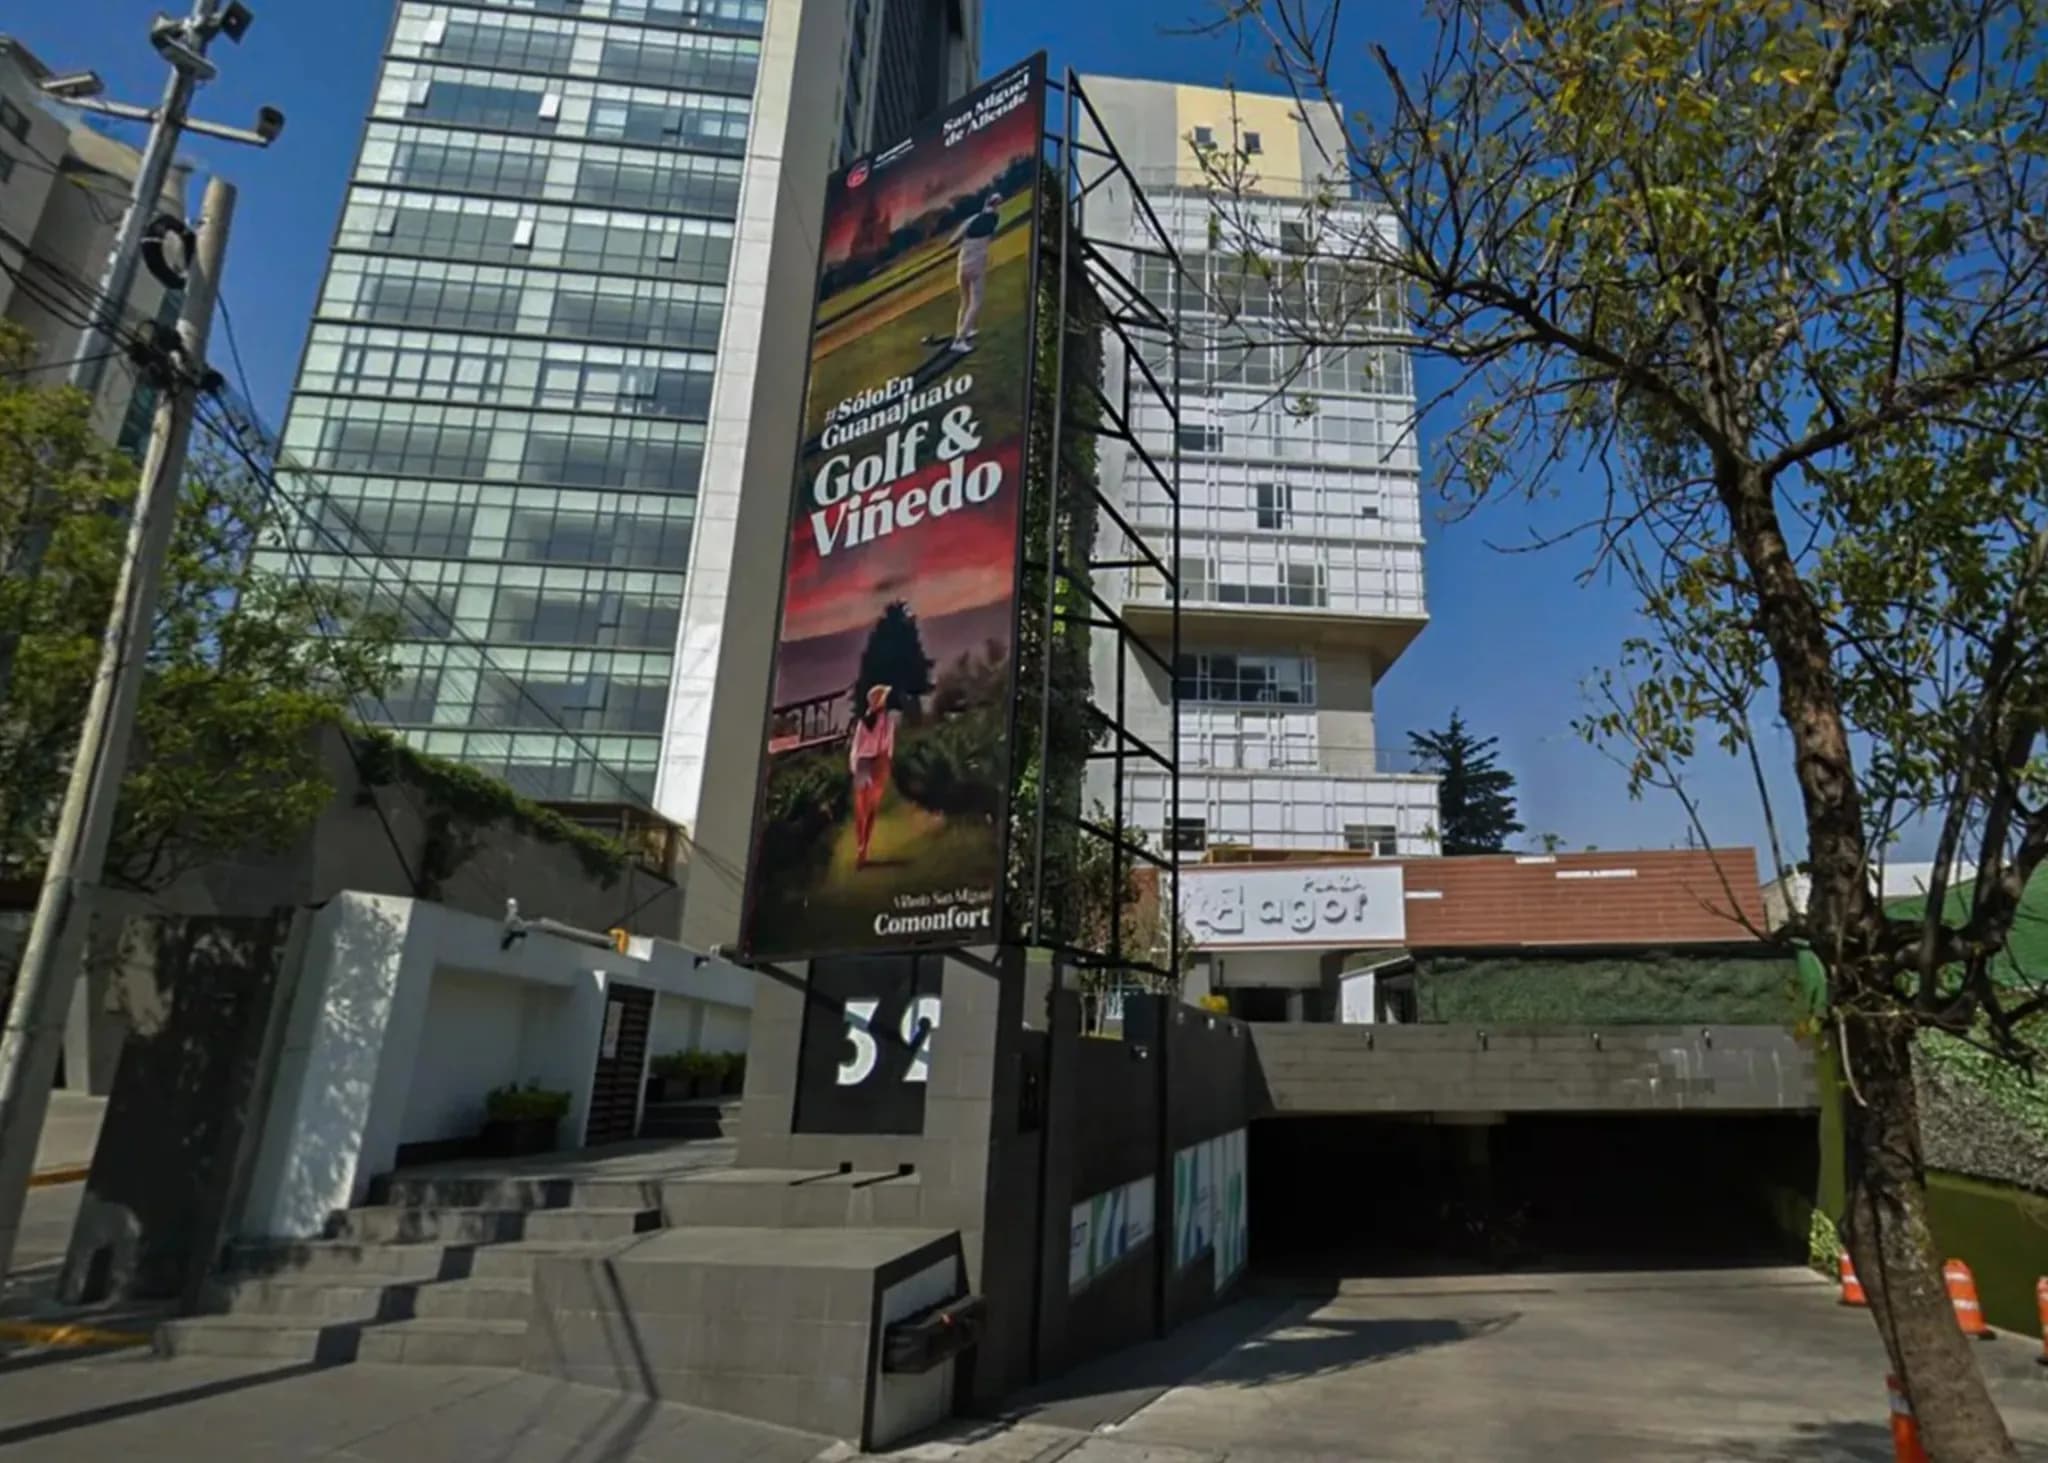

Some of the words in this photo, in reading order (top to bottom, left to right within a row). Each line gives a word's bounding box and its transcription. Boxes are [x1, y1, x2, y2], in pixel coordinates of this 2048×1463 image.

[943, 109, 974, 136] San
[975, 72, 1030, 114] Miguel
[944, 127, 964, 147] de
[967, 91, 1029, 137] Allende
[820, 373, 974, 450] Guanajuato
[824, 375, 915, 424] #SóloEn
[813, 421, 929, 507] Golf
[936, 404, 982, 461] &
[810, 456, 1003, 557] Viñedo
[873, 906, 990, 936] Comonfort
